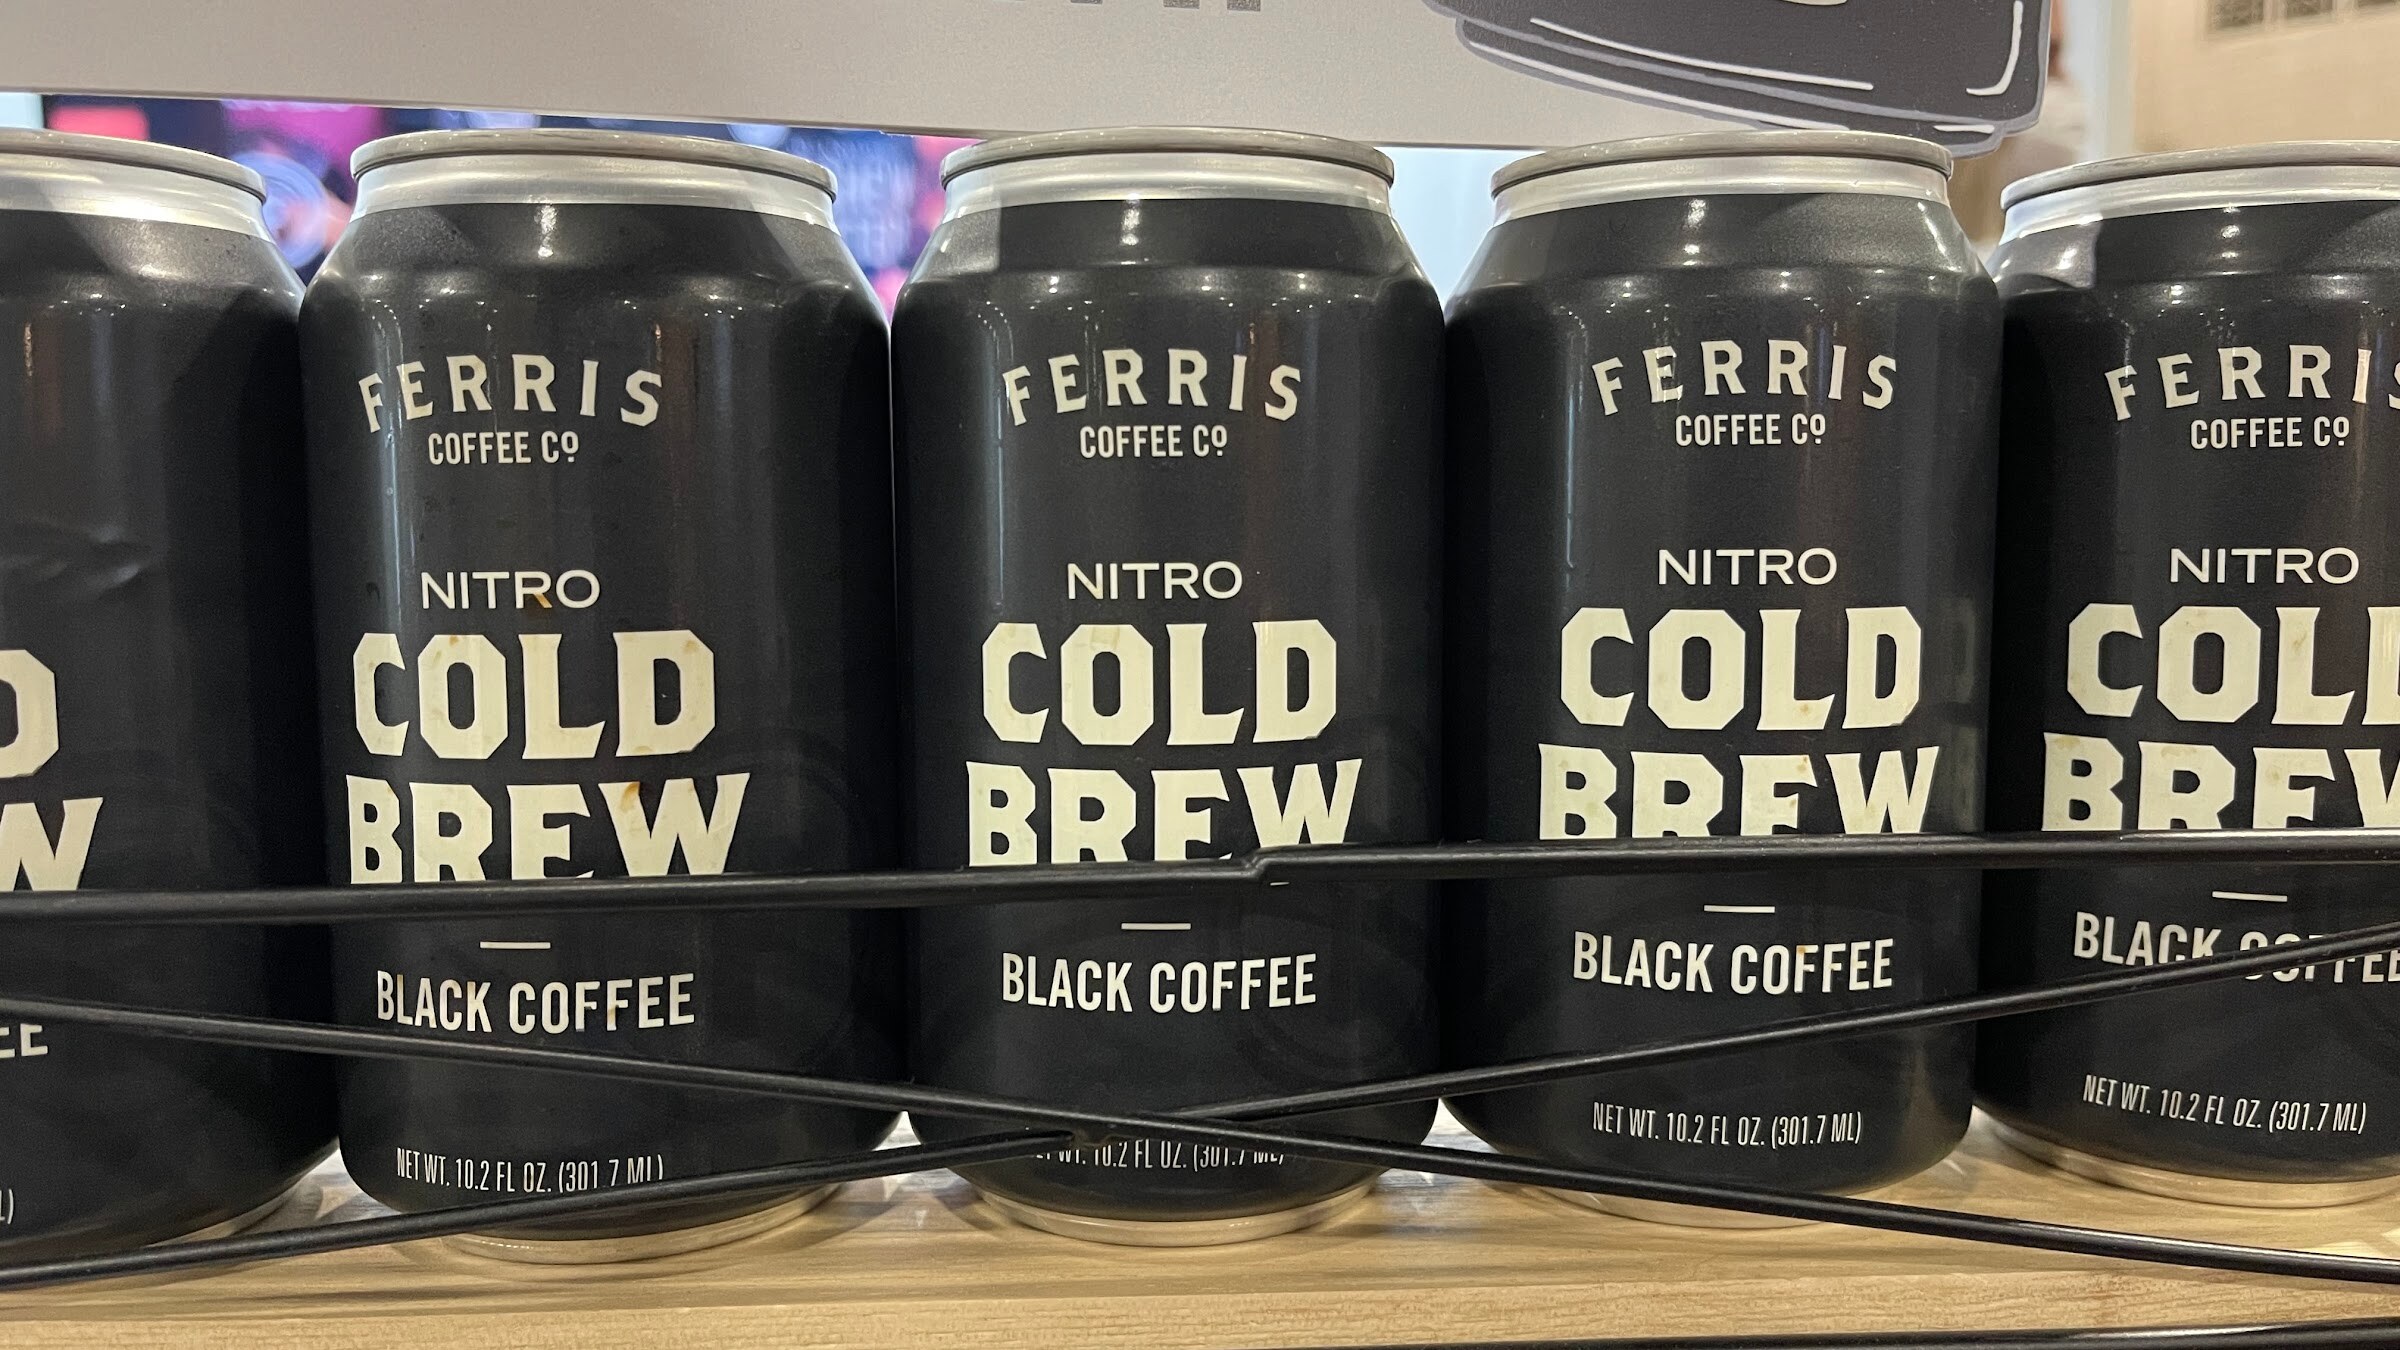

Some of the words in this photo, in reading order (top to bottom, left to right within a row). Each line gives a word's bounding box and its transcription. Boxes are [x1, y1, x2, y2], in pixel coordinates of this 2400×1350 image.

[358, 354, 663, 433] FERRIS
[1002, 348, 1301, 426] FERRIS
[1592, 339, 1896, 416] FERRIS
[428, 430, 531, 465] COFFEE
[1079, 424, 1183, 458] COFFEE
[1675, 413, 1781, 446] COFFEE
[2190, 416, 2303, 450] COFFEE
[421, 569, 600, 609] NITRO
[1067, 560, 1243, 600] NITRO
[1658, 547, 1837, 586] NITRO
[2170, 547, 2360, 584] NITRO
[353, 629, 716, 760] COLD
[982, 619, 1337, 746] COLD
[1560, 606, 1922, 731] COLD
[346, 772, 750, 884] BREW
[966, 758, 1362, 868] BREW
[1573, 930, 1714, 993] BLACK
[1730, 938, 1894, 995] COFFEE
[2074, 911, 2222, 966] BLACK
[377, 970, 493, 1033] BLACK
[509, 973, 695, 1034] COFFEE
[1002, 952, 1133, 1013] BLACK
[1149, 953, 1316, 1013] COFFEE
[1593, 1102, 1622, 1134] NET
[1629, 1107, 1659, 1140] WT.
[1667, 1112, 1703, 1144] 10.2
[1711, 1115, 1729, 1145] FL
[1737, 1117, 1765, 1146] OZ.
[1771, 1115, 1827, 1150] (301.7
[1831, 1111, 1863, 1145] ML)
[2083, 1074, 2117, 1107] NET
[2121, 1081, 2151, 1114] WT.
[2160, 1088, 2200, 1121] 10.2
[2204, 1095, 2224, 1124] FL
[2232, 1098, 2262, 1128] OZ.
[2268, 1100, 2330, 1133] (301.7
[2332, 1102, 2367, 1134] ML)
[397, 1147, 420, 1181] NET
[424, 1153, 450, 1186] WT.
[455, 1158, 490, 1191] 10.2
[496, 1161, 515, 1192] FL
[523, 1162, 552, 1193] OZ.
[558, 1159, 619, 1193] (3017
[1135, 1139, 1153, 1168] FL
[1160, 1140, 1187, 1168] OZ.
